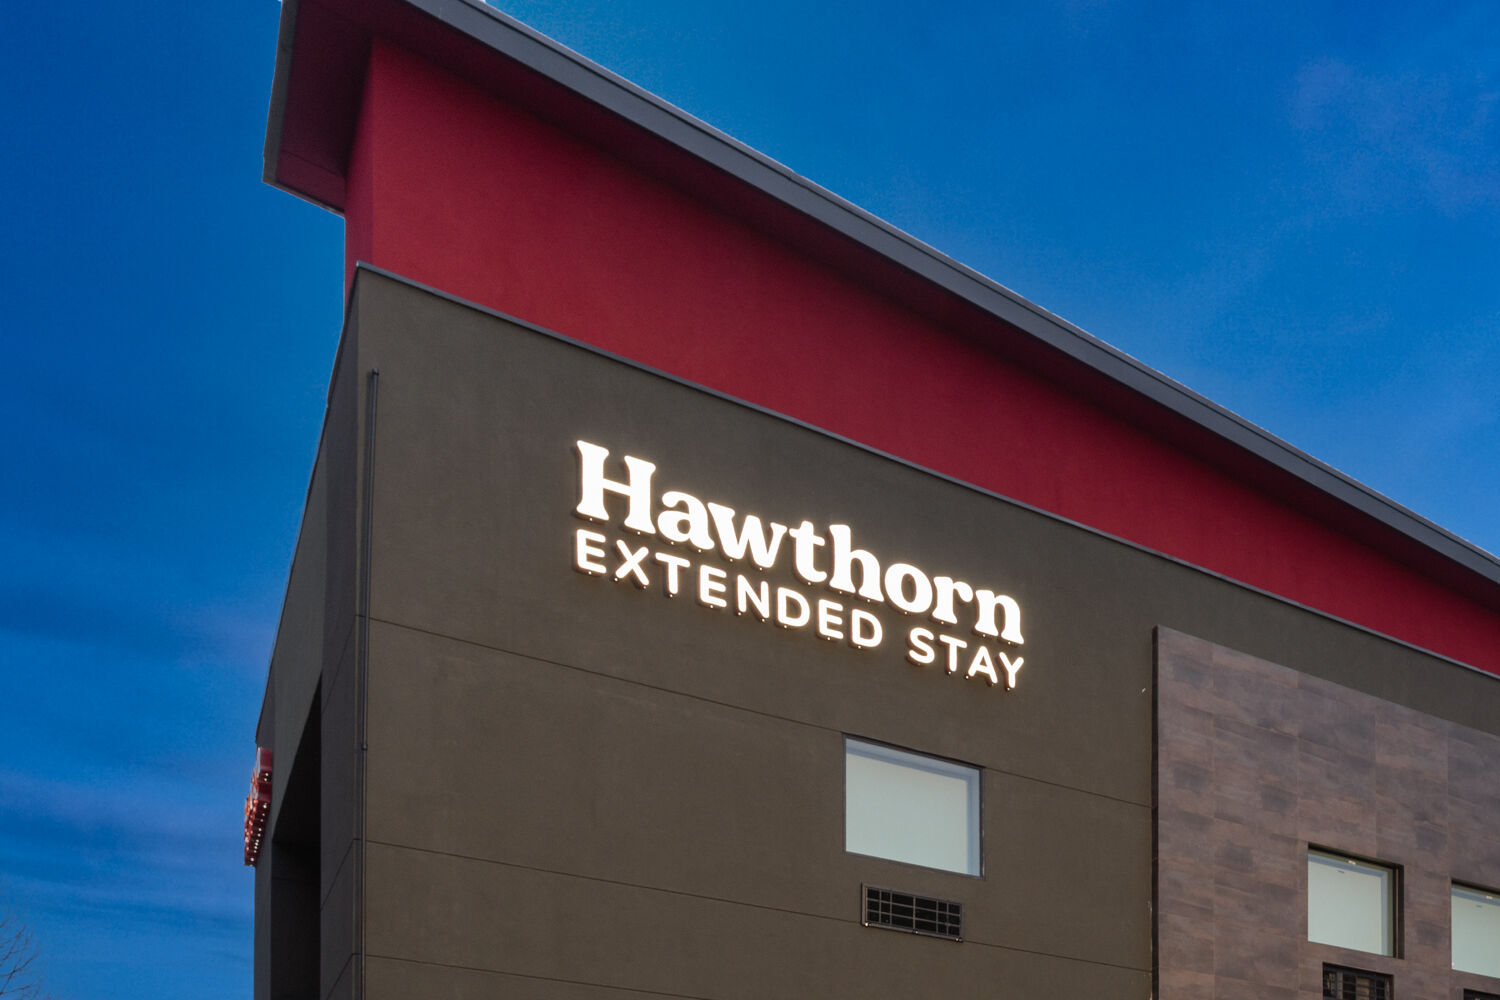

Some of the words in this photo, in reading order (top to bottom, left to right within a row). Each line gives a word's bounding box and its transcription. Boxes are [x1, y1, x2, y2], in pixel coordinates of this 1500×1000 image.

[576, 439, 1025, 645] Hawthorn
[576, 528, 884, 648] EXTENDED
[908, 626, 1025, 688] STAY
